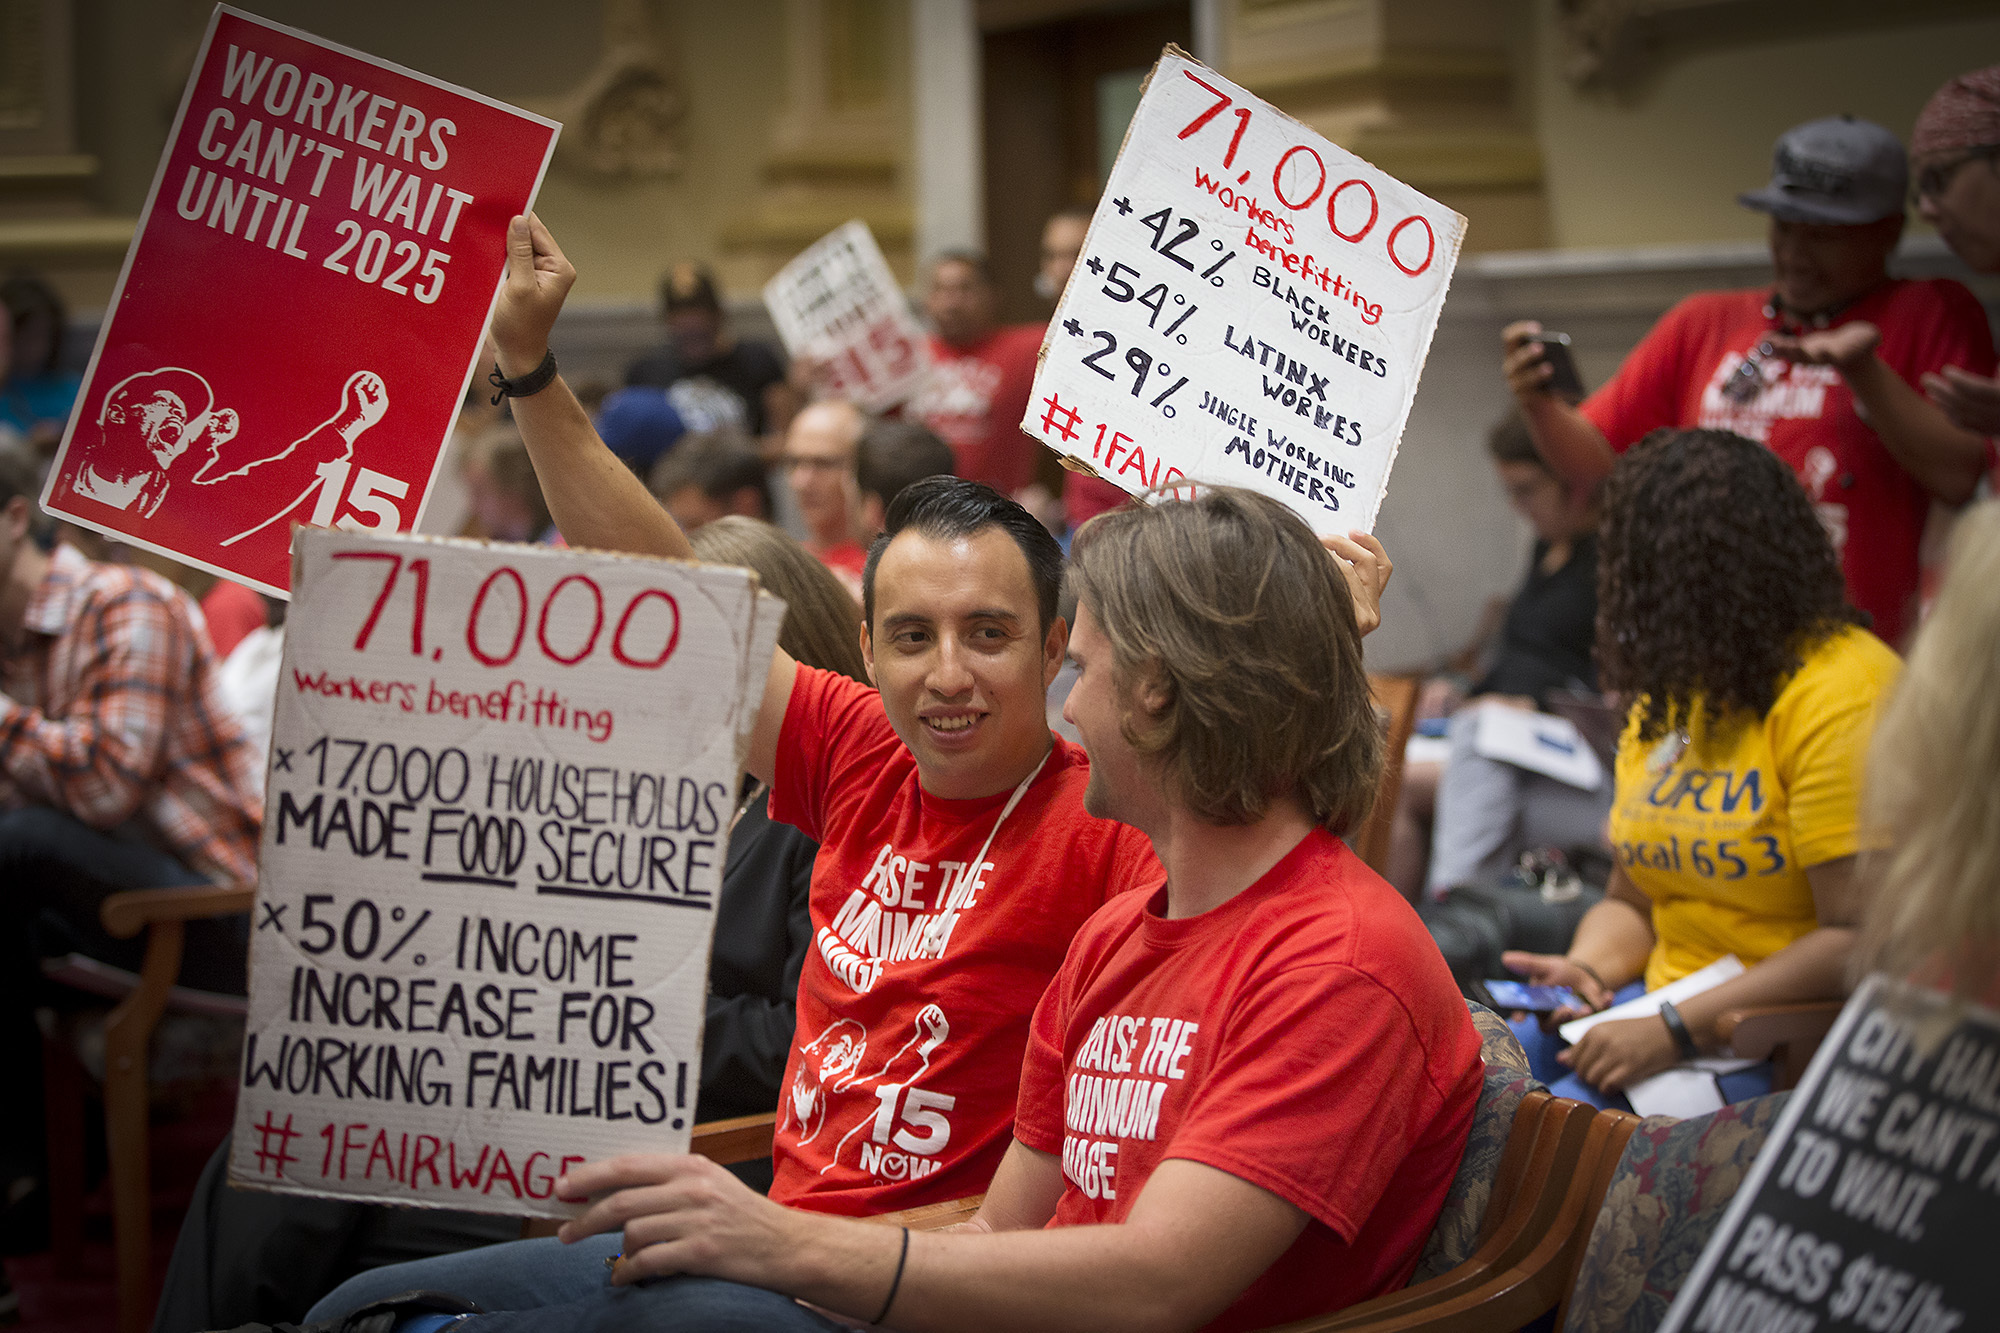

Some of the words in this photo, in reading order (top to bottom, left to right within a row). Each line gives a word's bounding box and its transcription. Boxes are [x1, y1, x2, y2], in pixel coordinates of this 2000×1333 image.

[221, 43, 457, 171] WORKERS
[198, 107, 344, 198] CAN'T
[350, 156, 474, 243] WAIT
[1177, 69, 1435, 278] 71,000
[176, 165, 310, 260] UNTIL
[322, 219, 452, 304] 2025
[1245, 227, 1383, 325] benefitting
[1252, 265, 1330, 325] BLACK
[1223, 324, 1330, 402] LATINX
[1290, 310, 1387, 378] WORKERS
[1199, 391, 1258, 438] SINGLE
[1267, 428, 1356, 489] WORKING
[1224, 435, 1340, 512] MOTHERS
[310, 458, 410, 533] 15
[427, 678, 613, 742] benefitting
[487, 755, 727, 835] HOUSEHOLDS
[276, 792, 416, 859] MADE
[424, 808, 526, 876] FOOD
[537, 820, 715, 896] SECURE
[1690, 833, 1787, 881] 653
[935, 860, 995, 910] THE
[300, 895, 432, 966] 50%
[456, 917, 637, 987] INCOME
[290, 966, 538, 1040] INCREASE
[558, 991, 655, 1054] FOR
[1076, 1015, 1146, 1074] RAISE
[1139, 1017, 1199, 1080] THE
[244, 1033, 452, 1107] WORKING
[466, 1050, 688, 1130] FAMILIES!
[872, 1083, 956, 1156] 15
[1066, 1073, 1168, 1141] MINIMUM
[859, 1141, 943, 1181] NOW
[1778, 1128, 1841, 1198] TO
[1812, 1065, 1892, 1142] WE
[1874, 1092, 1998, 1182] CAN'T
[1727, 1212, 1844, 1302] PASS
